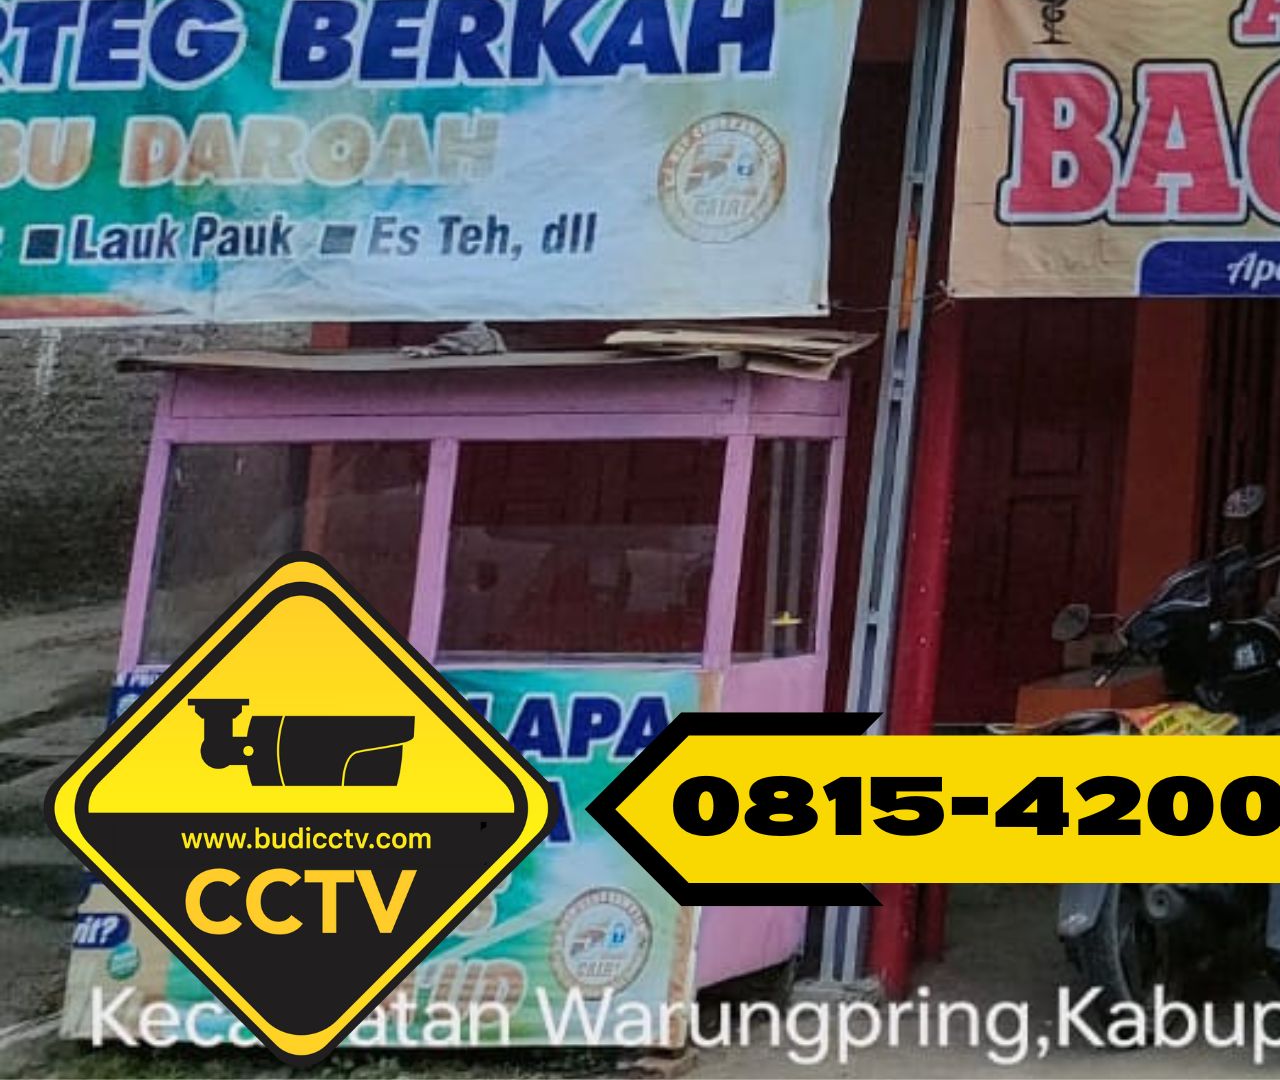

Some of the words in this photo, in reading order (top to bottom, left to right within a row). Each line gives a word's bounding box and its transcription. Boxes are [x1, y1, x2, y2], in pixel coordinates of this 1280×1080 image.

[121, 113, 503, 188] DAROAH
[71, 217, 181, 261] Lauk
[192, 215, 294, 258] Pauk
[368, 215, 421, 257] Es
[438, 214, 523, 262] Teh,
[541, 212, 598, 255] dll
